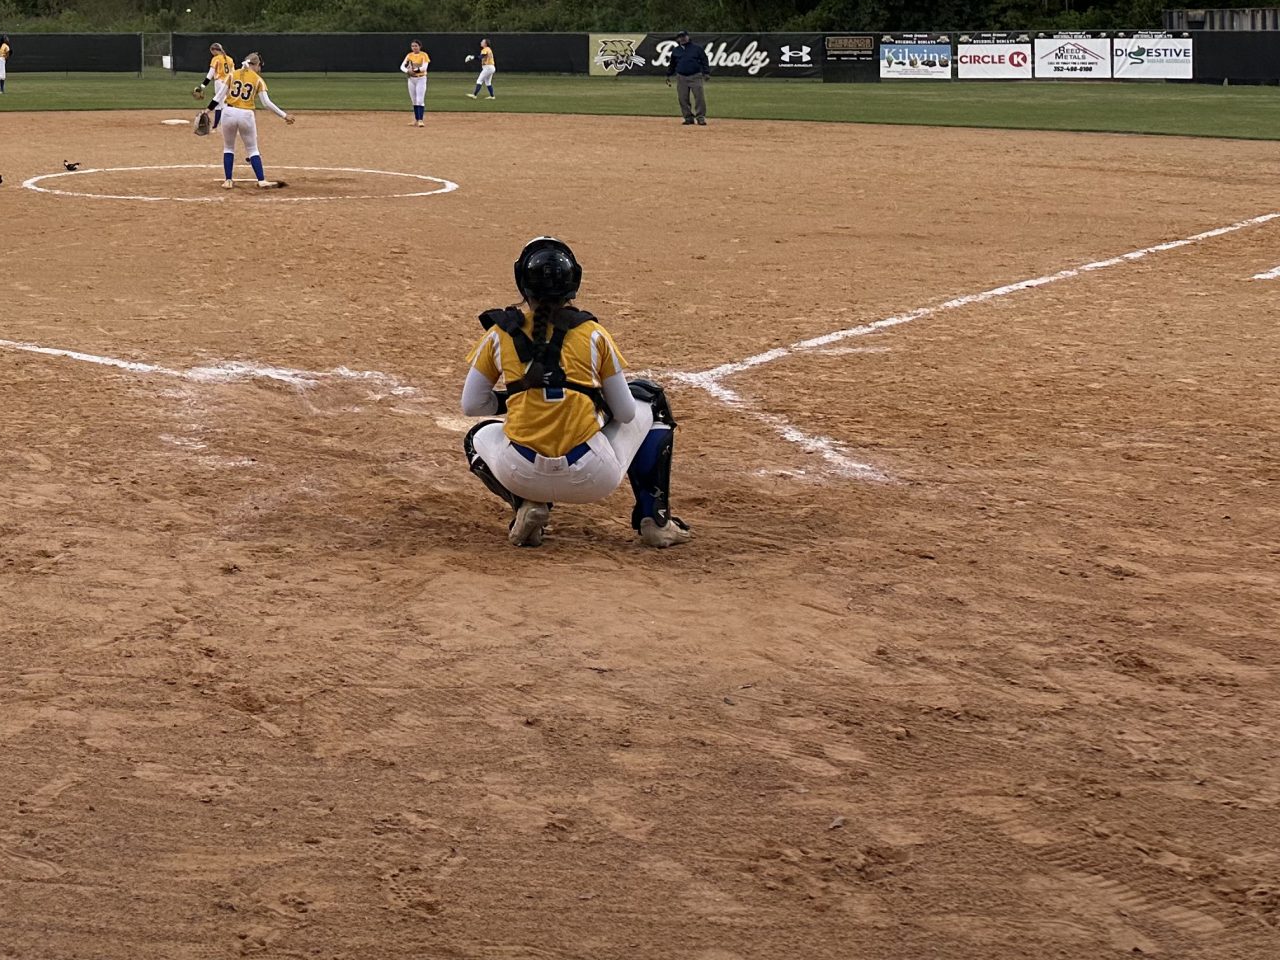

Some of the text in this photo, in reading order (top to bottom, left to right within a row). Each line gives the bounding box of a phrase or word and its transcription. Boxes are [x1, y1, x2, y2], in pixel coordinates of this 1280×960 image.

[884, 48, 948, 61] Kilwins
[959, 54, 1026, 65] CIRCLE K
[223, 62, 229, 74] 8
[231, 81, 253, 100] 33
